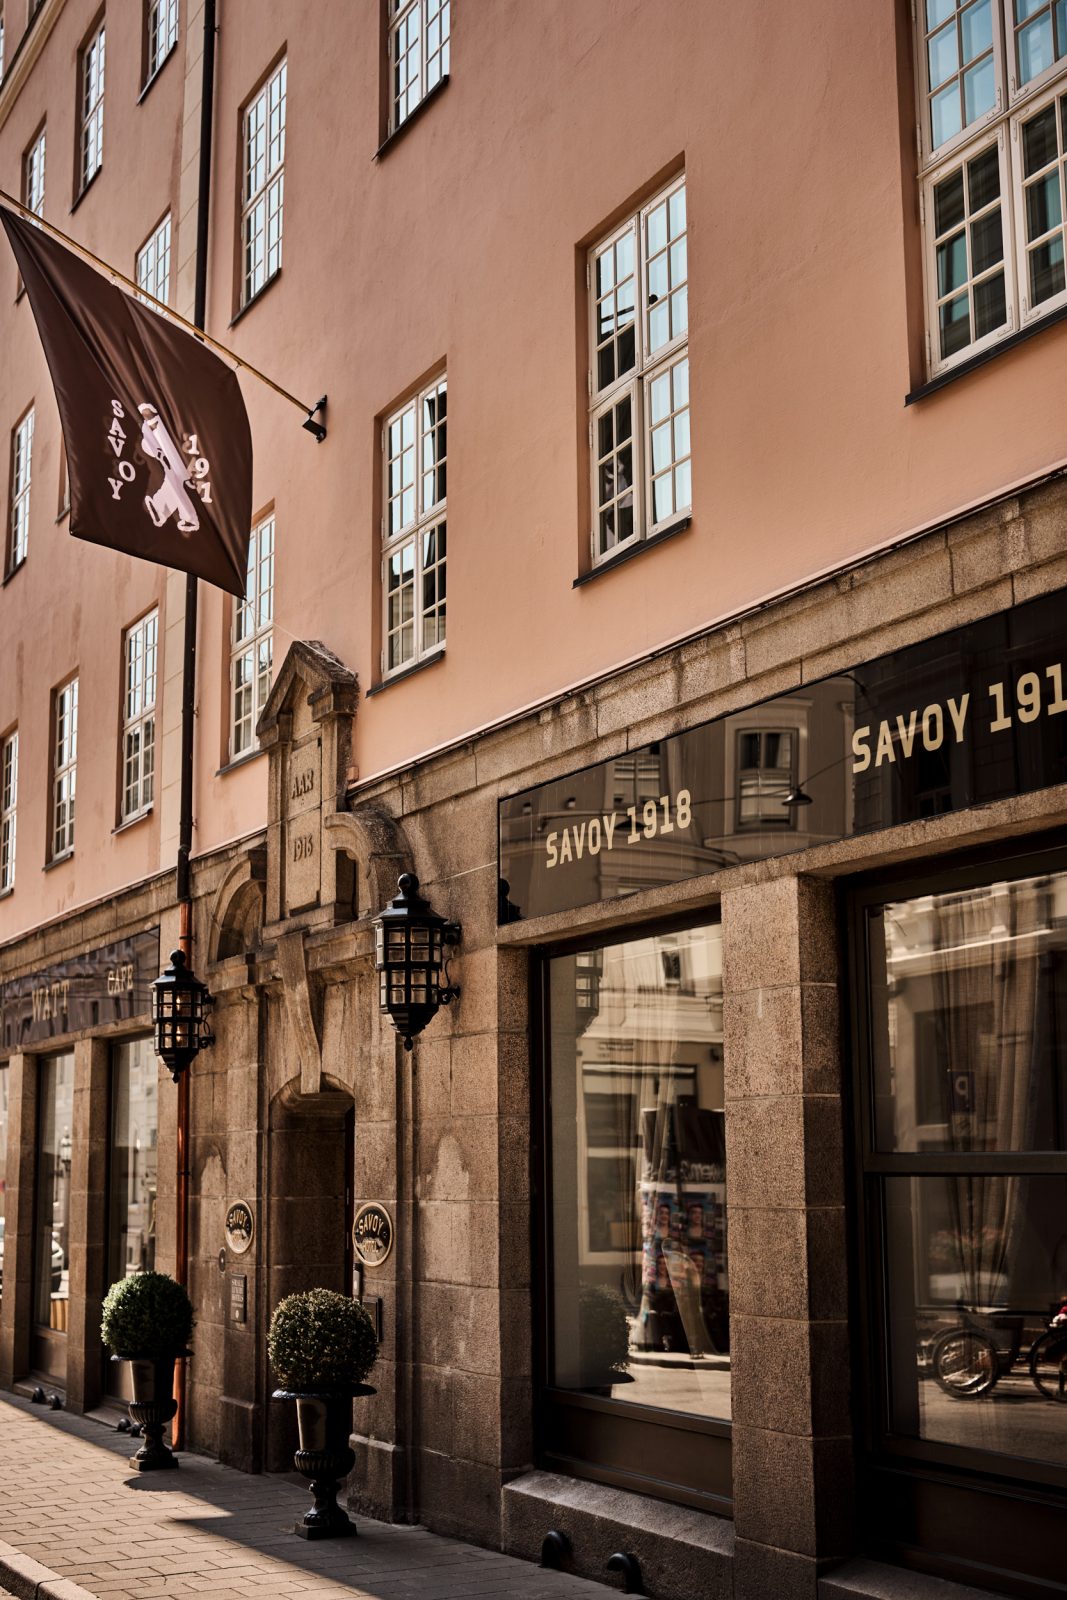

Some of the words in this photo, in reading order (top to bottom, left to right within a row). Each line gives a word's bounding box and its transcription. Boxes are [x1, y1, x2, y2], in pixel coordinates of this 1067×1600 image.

[107, 399, 136, 500] SAVOY
[852, 692, 970, 774] SAVOY
[988, 662, 1067, 733] 191
[546, 811, 617, 869] SAVOY
[627, 789, 692, 845] 1918
[229, 1209, 247, 1228] SAVOY
[358, 1213, 384, 1236] SAVOY
